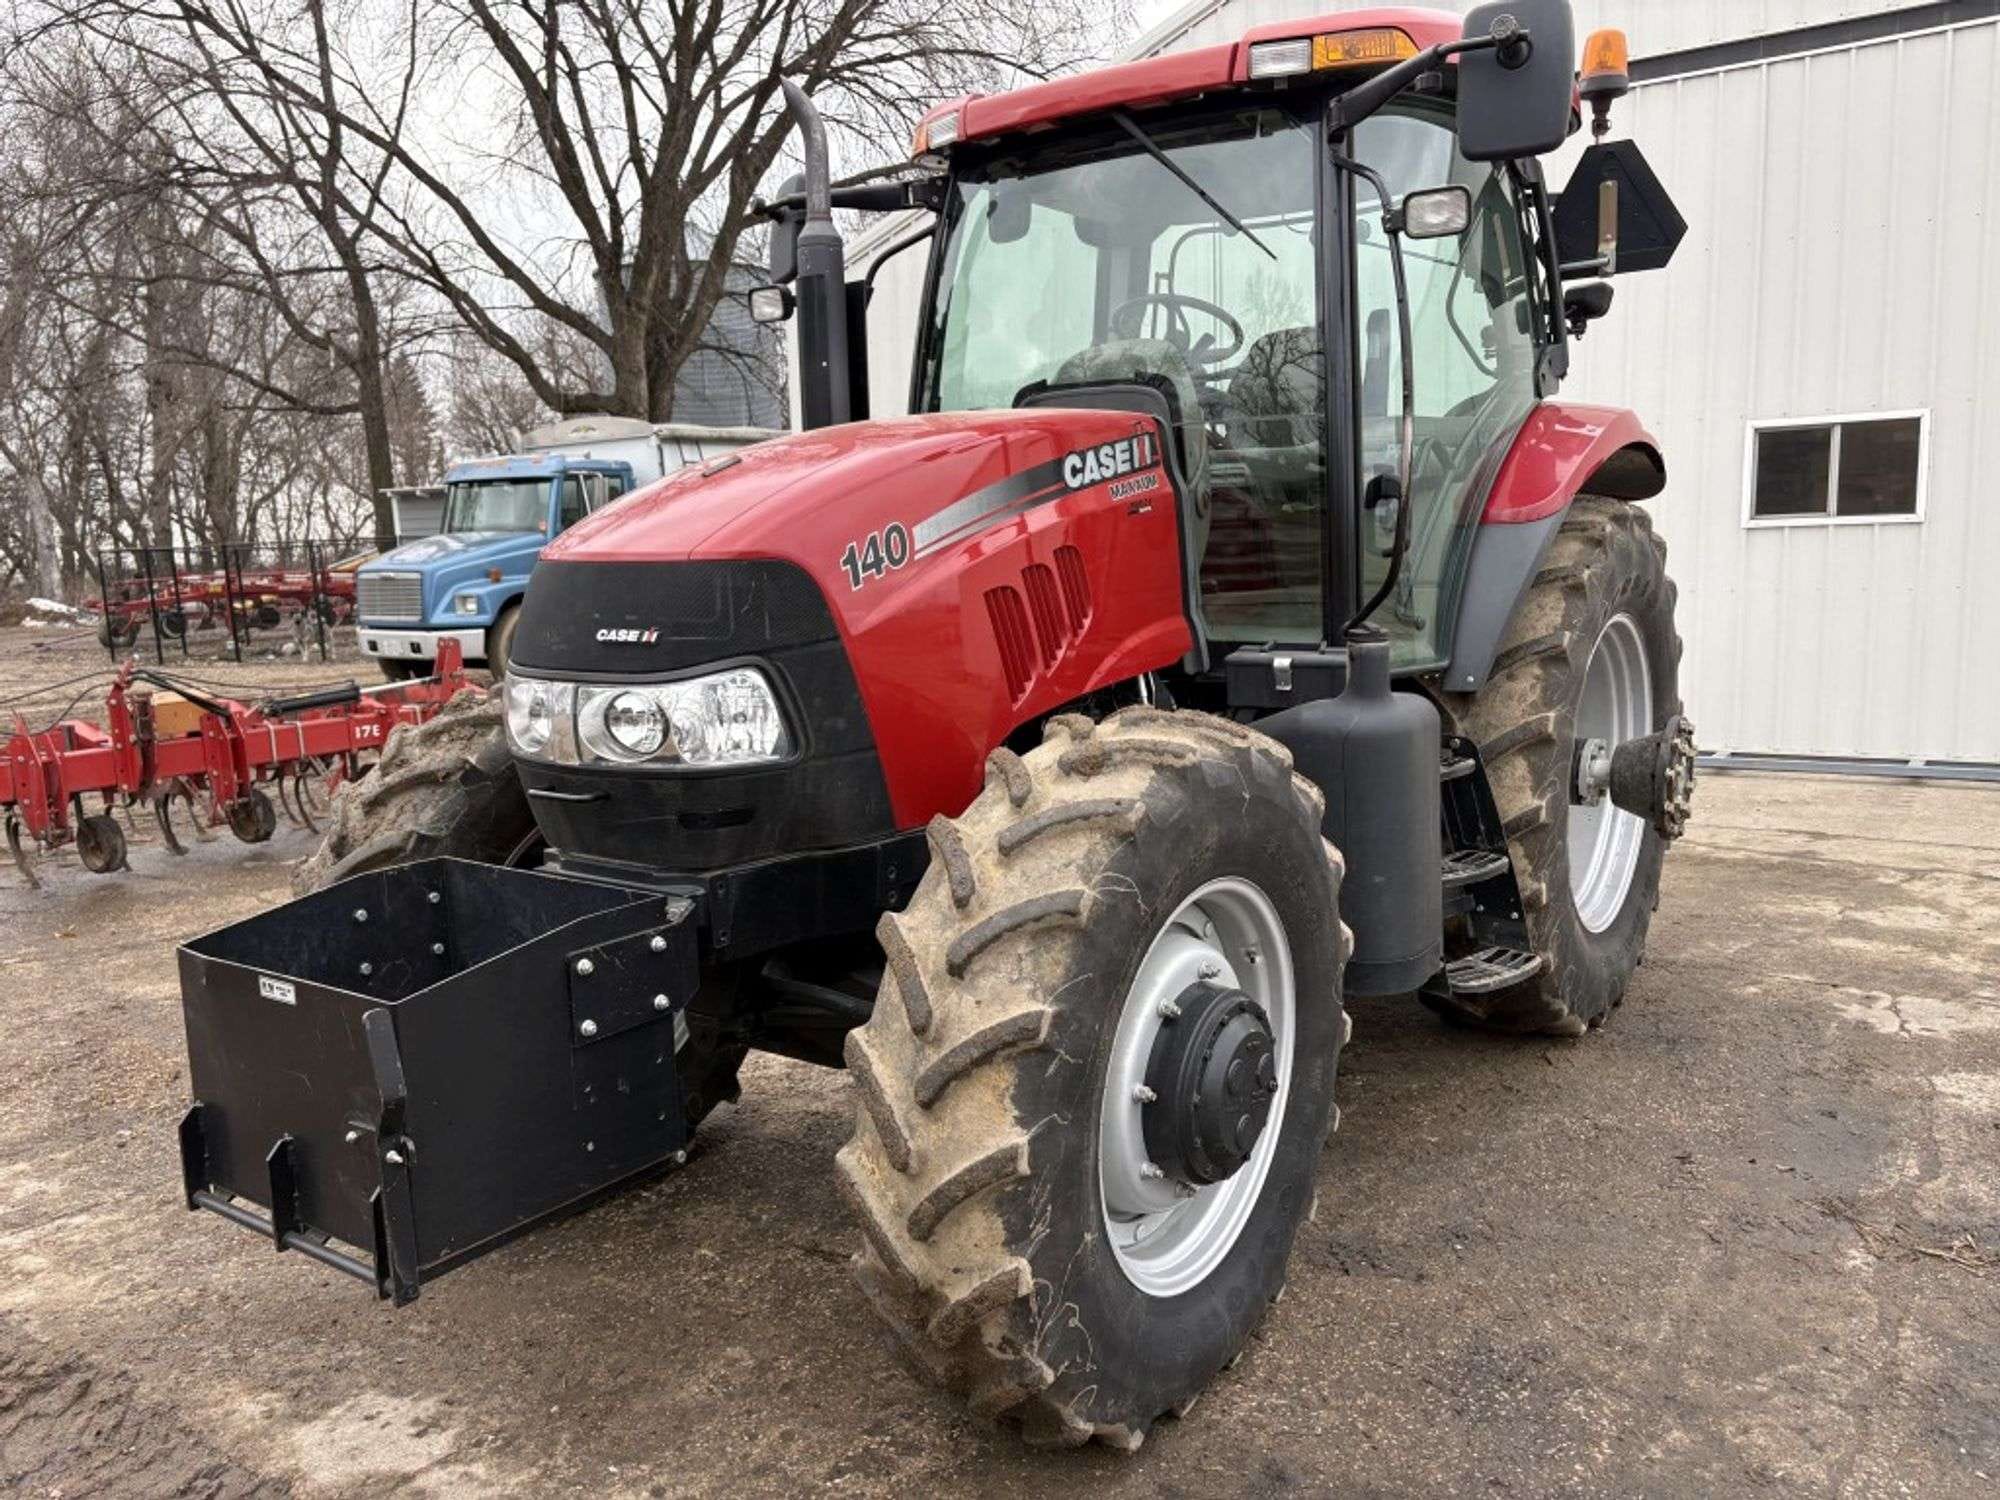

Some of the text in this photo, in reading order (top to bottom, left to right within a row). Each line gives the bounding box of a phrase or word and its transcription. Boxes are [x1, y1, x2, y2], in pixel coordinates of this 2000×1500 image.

[1063, 440, 1131, 488] CASE
[840, 522, 909, 591] 140
[596, 629, 640, 642] CASE
